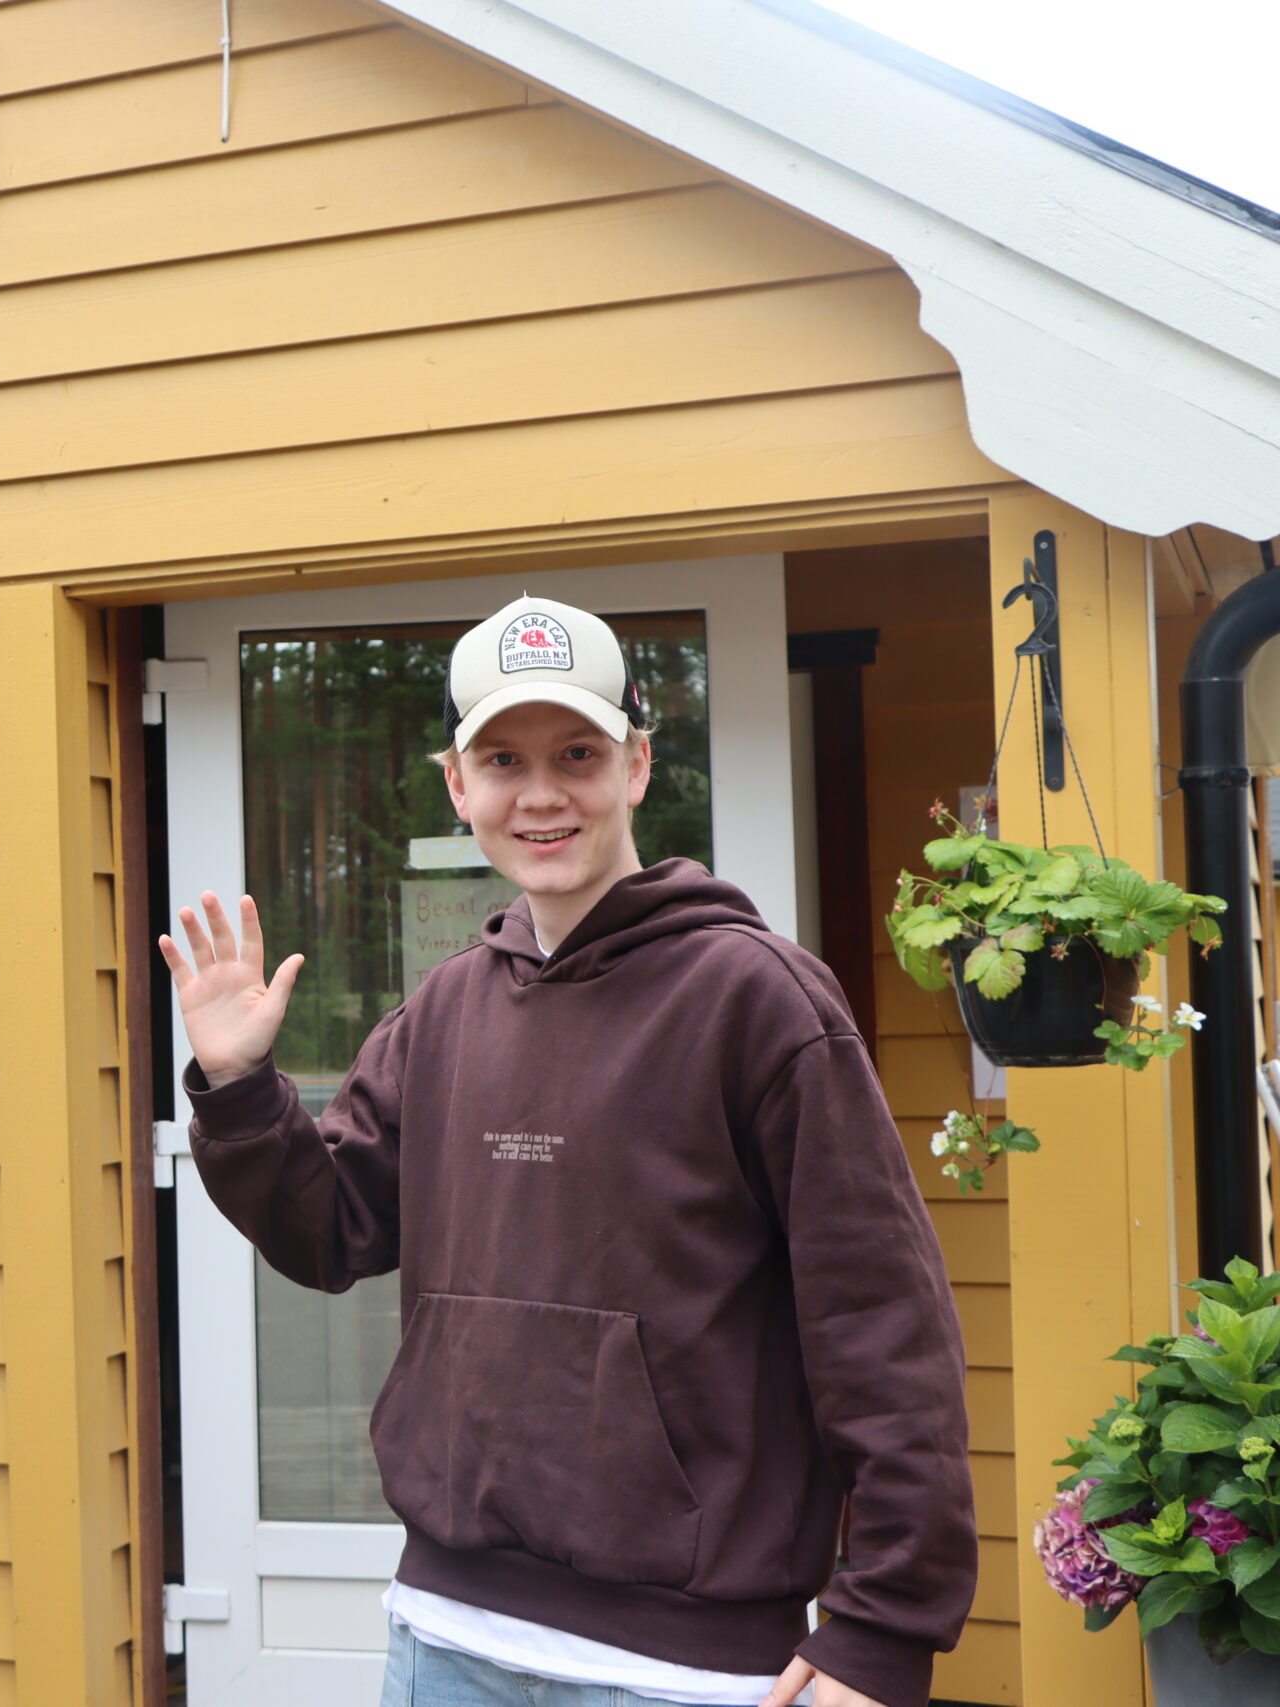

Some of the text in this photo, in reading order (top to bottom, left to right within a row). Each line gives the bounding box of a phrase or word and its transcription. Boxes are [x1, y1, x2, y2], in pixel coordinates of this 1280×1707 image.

[504, 617, 567, 651] NEW ERA CAP
[506, 650, 551, 663] BUFFALO,
[506, 659, 552, 669] ESTABLISHED
[417, 892, 477, 922] Betal
[483, 1132, 494, 1141] this
[495, 1132, 500, 1141] is
[500, 1134, 512, 1142] new
[513, 1132, 523, 1142] and
[533, 1134, 543, 1143] not
[543, 1133, 551, 1143] the
[499, 1142, 520, 1153] nothing
[520, 1143, 531, 1152] can
[544, 1142, 551, 1152] be
[492, 1149, 502, 1160] but
[502, 1150, 507, 1160] it
[507, 1150, 519, 1160] still
[519, 1152, 531, 1161] can
[531, 1151, 539, 1161] be
